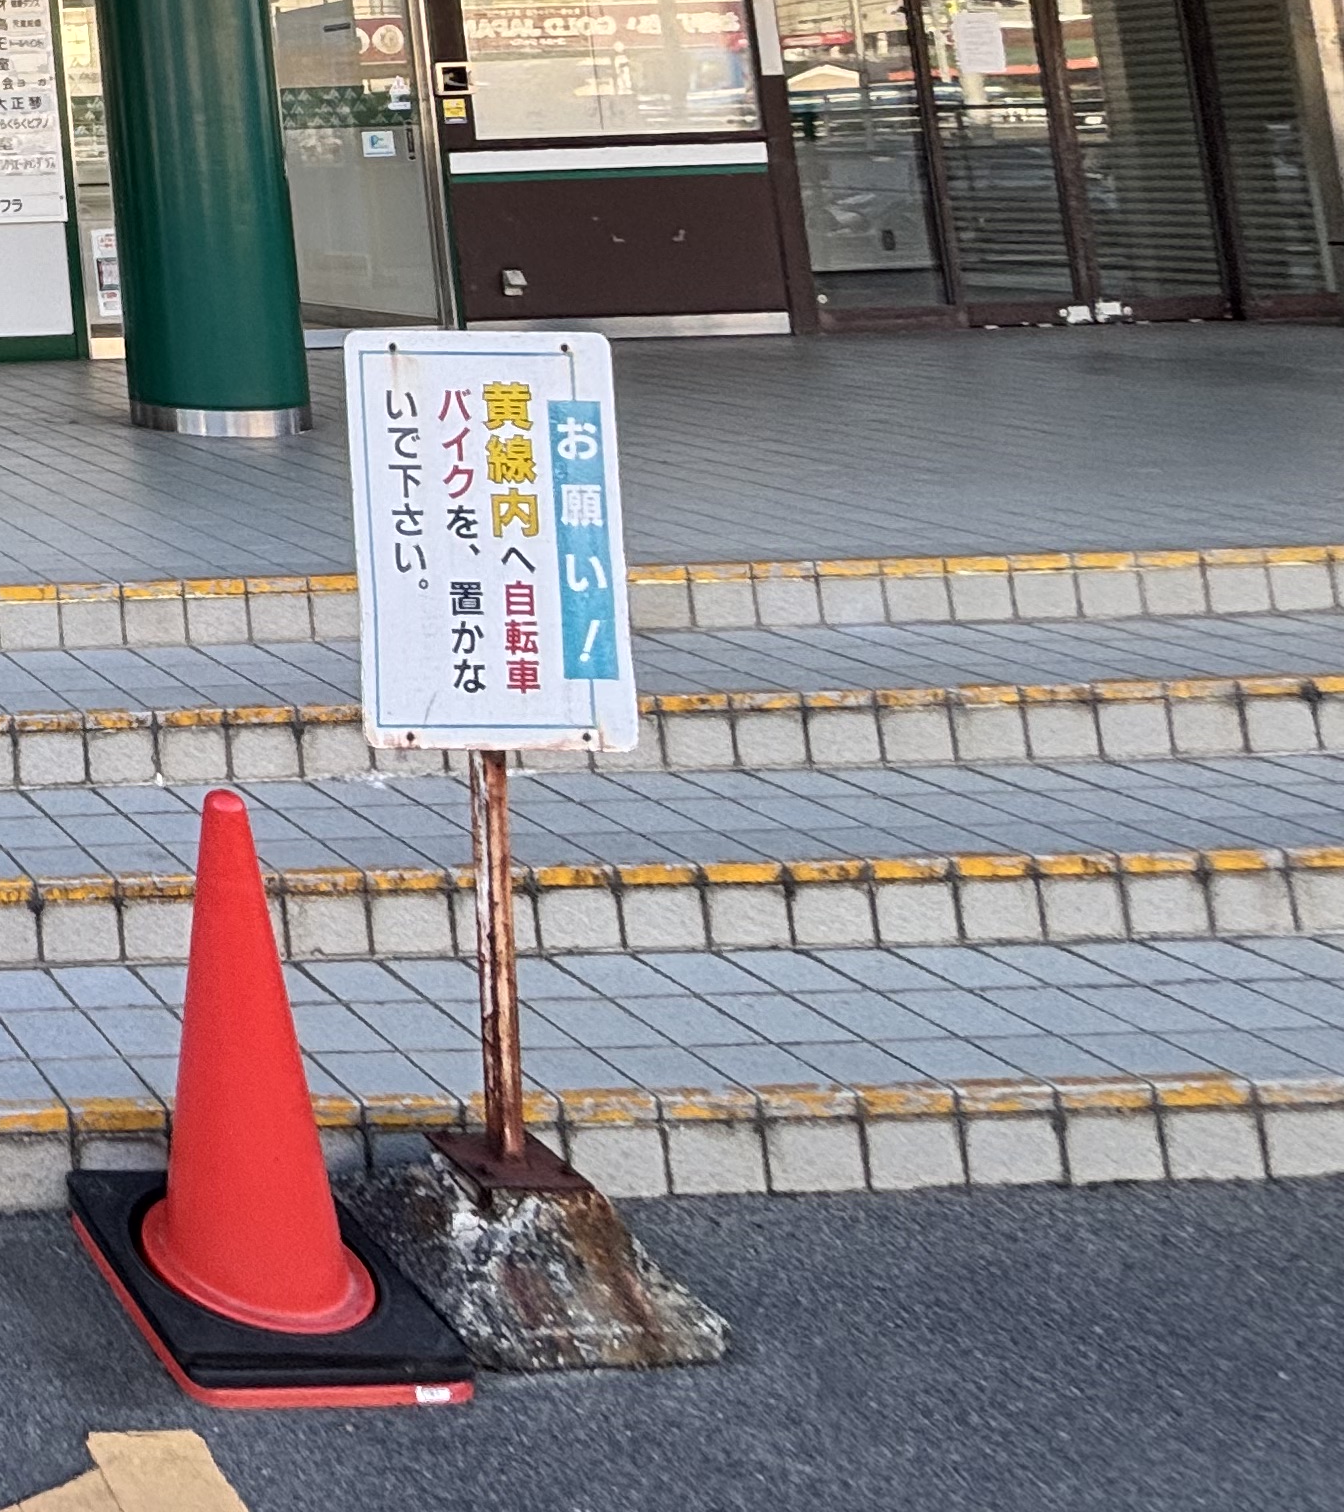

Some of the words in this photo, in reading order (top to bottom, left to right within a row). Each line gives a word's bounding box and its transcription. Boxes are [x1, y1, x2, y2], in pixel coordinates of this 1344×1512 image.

[385, 389, 430, 591] いで下さい。
